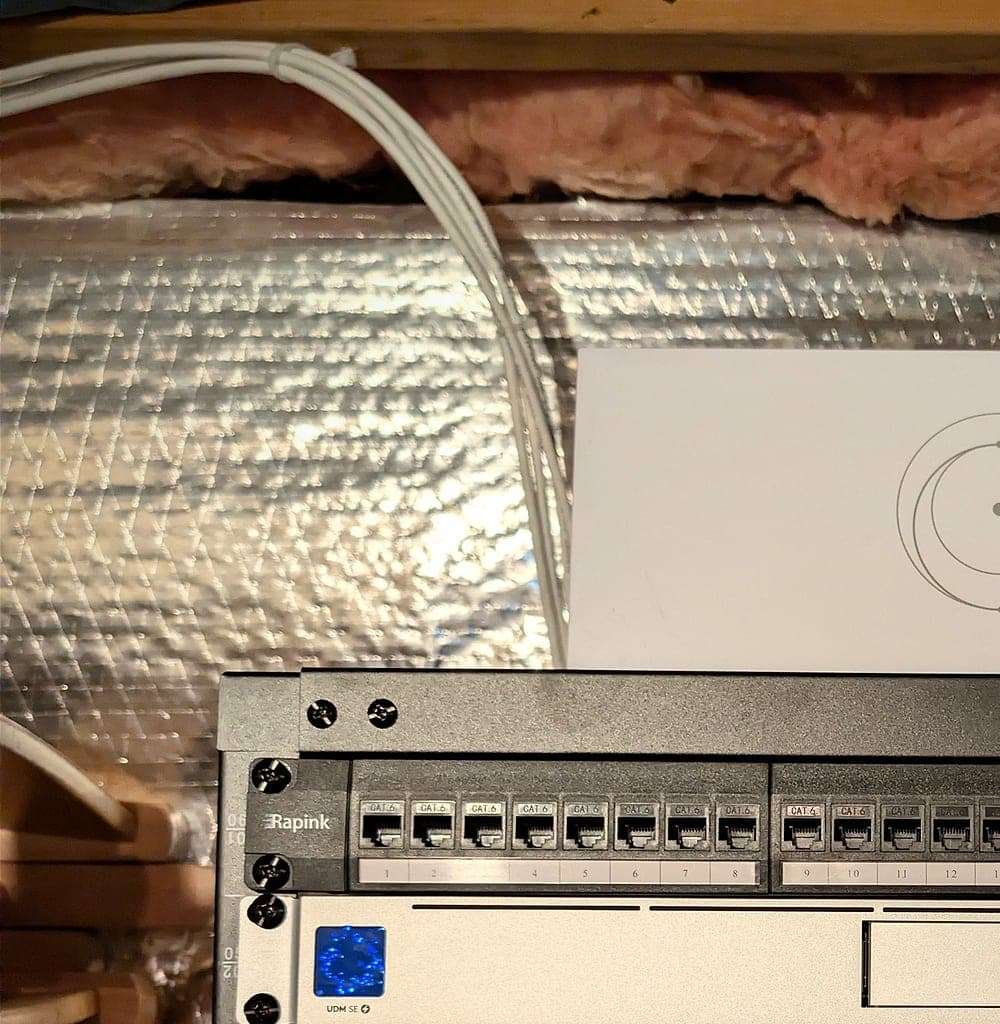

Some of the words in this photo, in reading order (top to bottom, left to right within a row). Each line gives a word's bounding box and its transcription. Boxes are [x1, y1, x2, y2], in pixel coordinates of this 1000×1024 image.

[370, 803, 396, 813] CAT.6
[420, 803, 446, 813] CAT.6
[471, 804, 497, 814] CAT.6
[523, 804, 549, 814] CAT.6
[573, 804, 599, 814] CAT.6
[725, 805, 751, 815] CAT.6
[790, 806, 816, 816] CAT.6
[840, 807, 866, 816] CAT.6
[271, 814, 330, 832] Rapink
[531, 868, 538, 878] 4
[582, 868, 588, 878] 5
[632, 868, 639, 878] 6
[682, 868, 689, 878] 7
[732, 868, 738, 878] 8
[803, 868, 810, 878] 9
[847, 869, 860, 878] 10
[896, 868, 907, 879] 11
[945, 868, 958, 879] 12
[326, 1005, 346, 1013] UDM
[348, 1005, 358, 1013] SE
